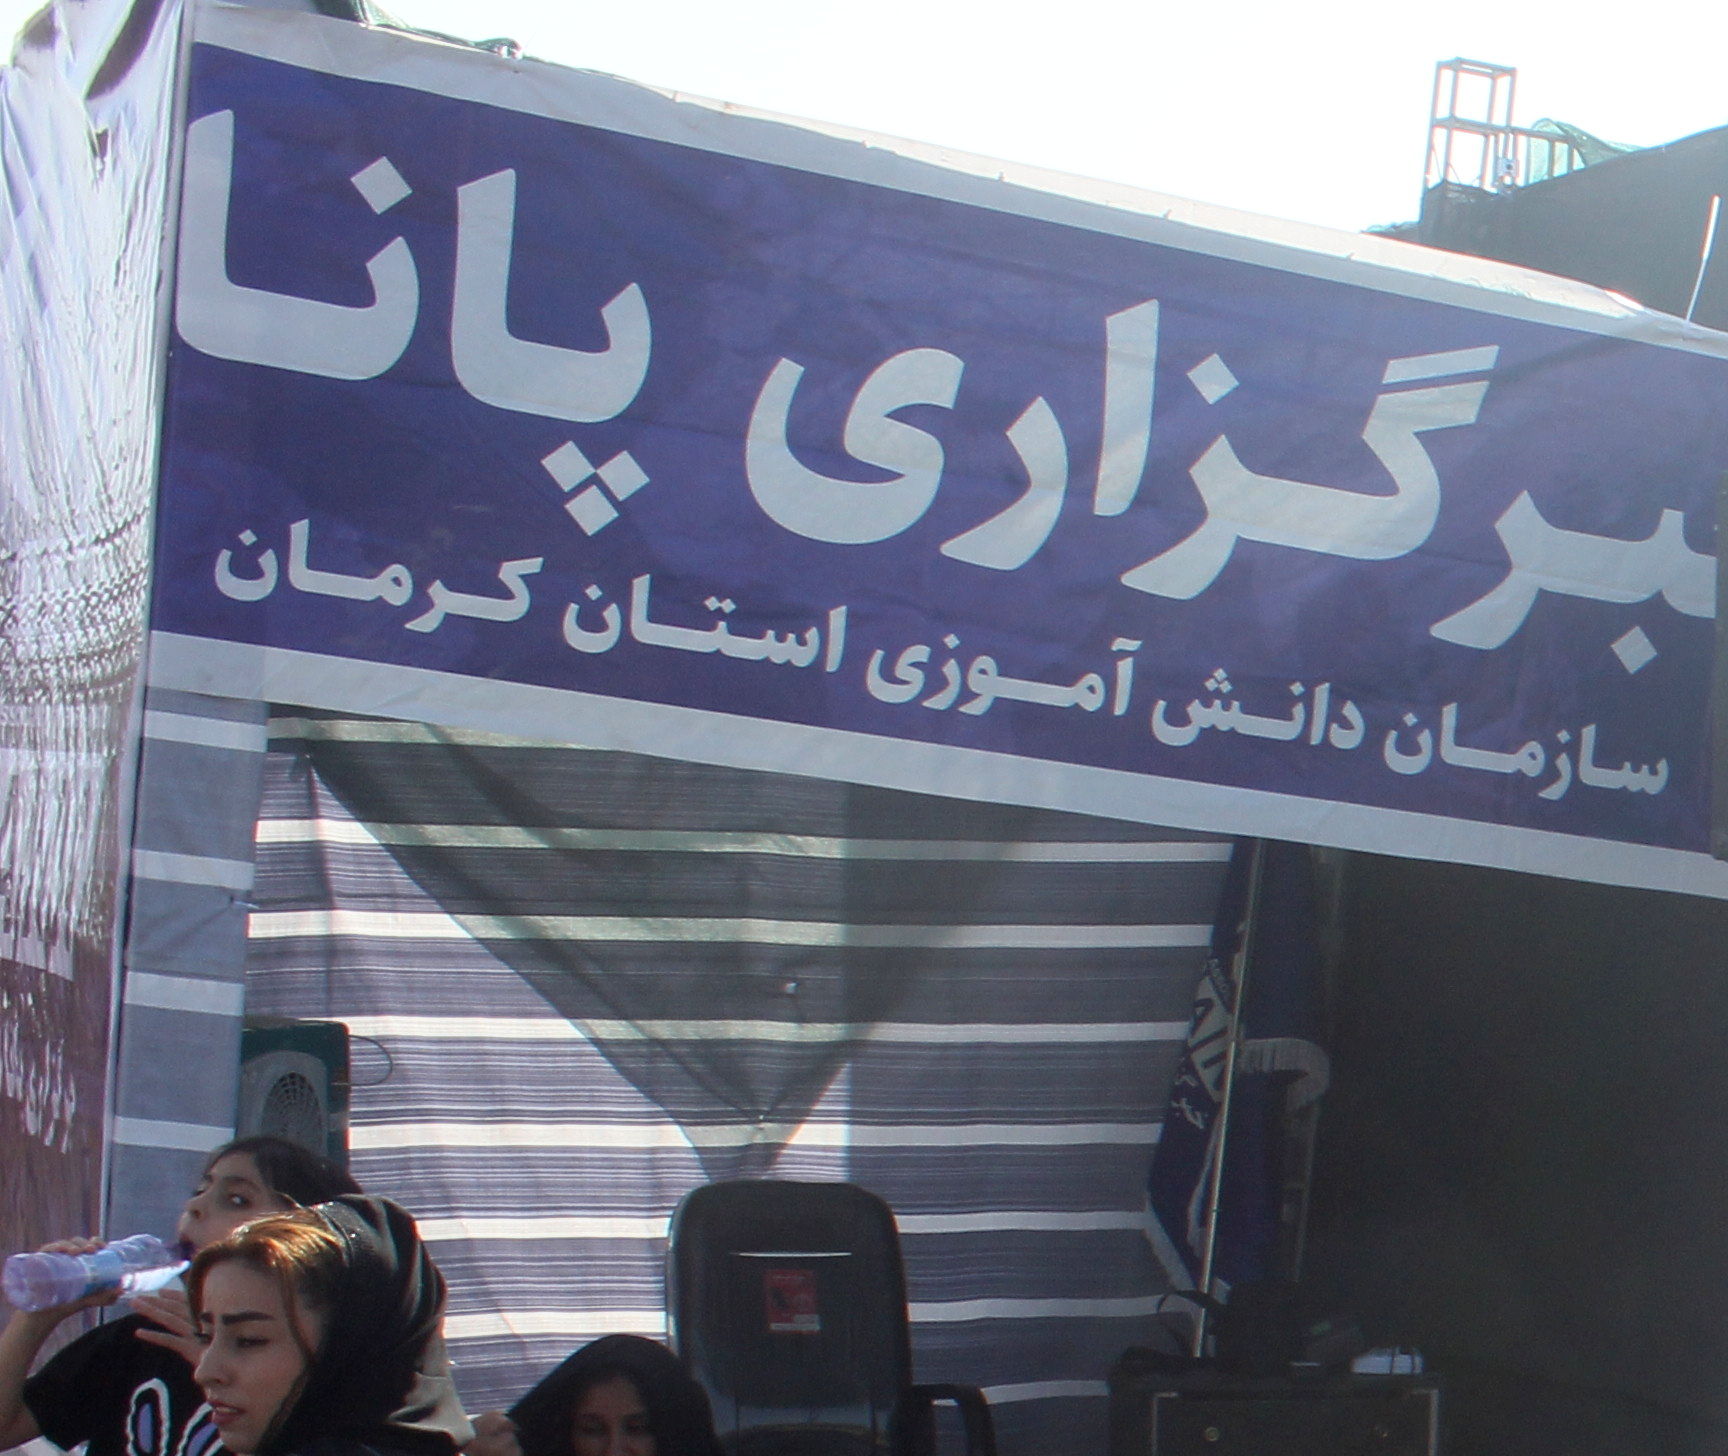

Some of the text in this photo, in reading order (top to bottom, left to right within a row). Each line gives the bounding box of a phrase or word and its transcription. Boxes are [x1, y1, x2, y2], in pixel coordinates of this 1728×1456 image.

[175, 108, 653, 536] پانا
[214, 519, 1669, 799] سازمان دانش آموزی استان کرمان
